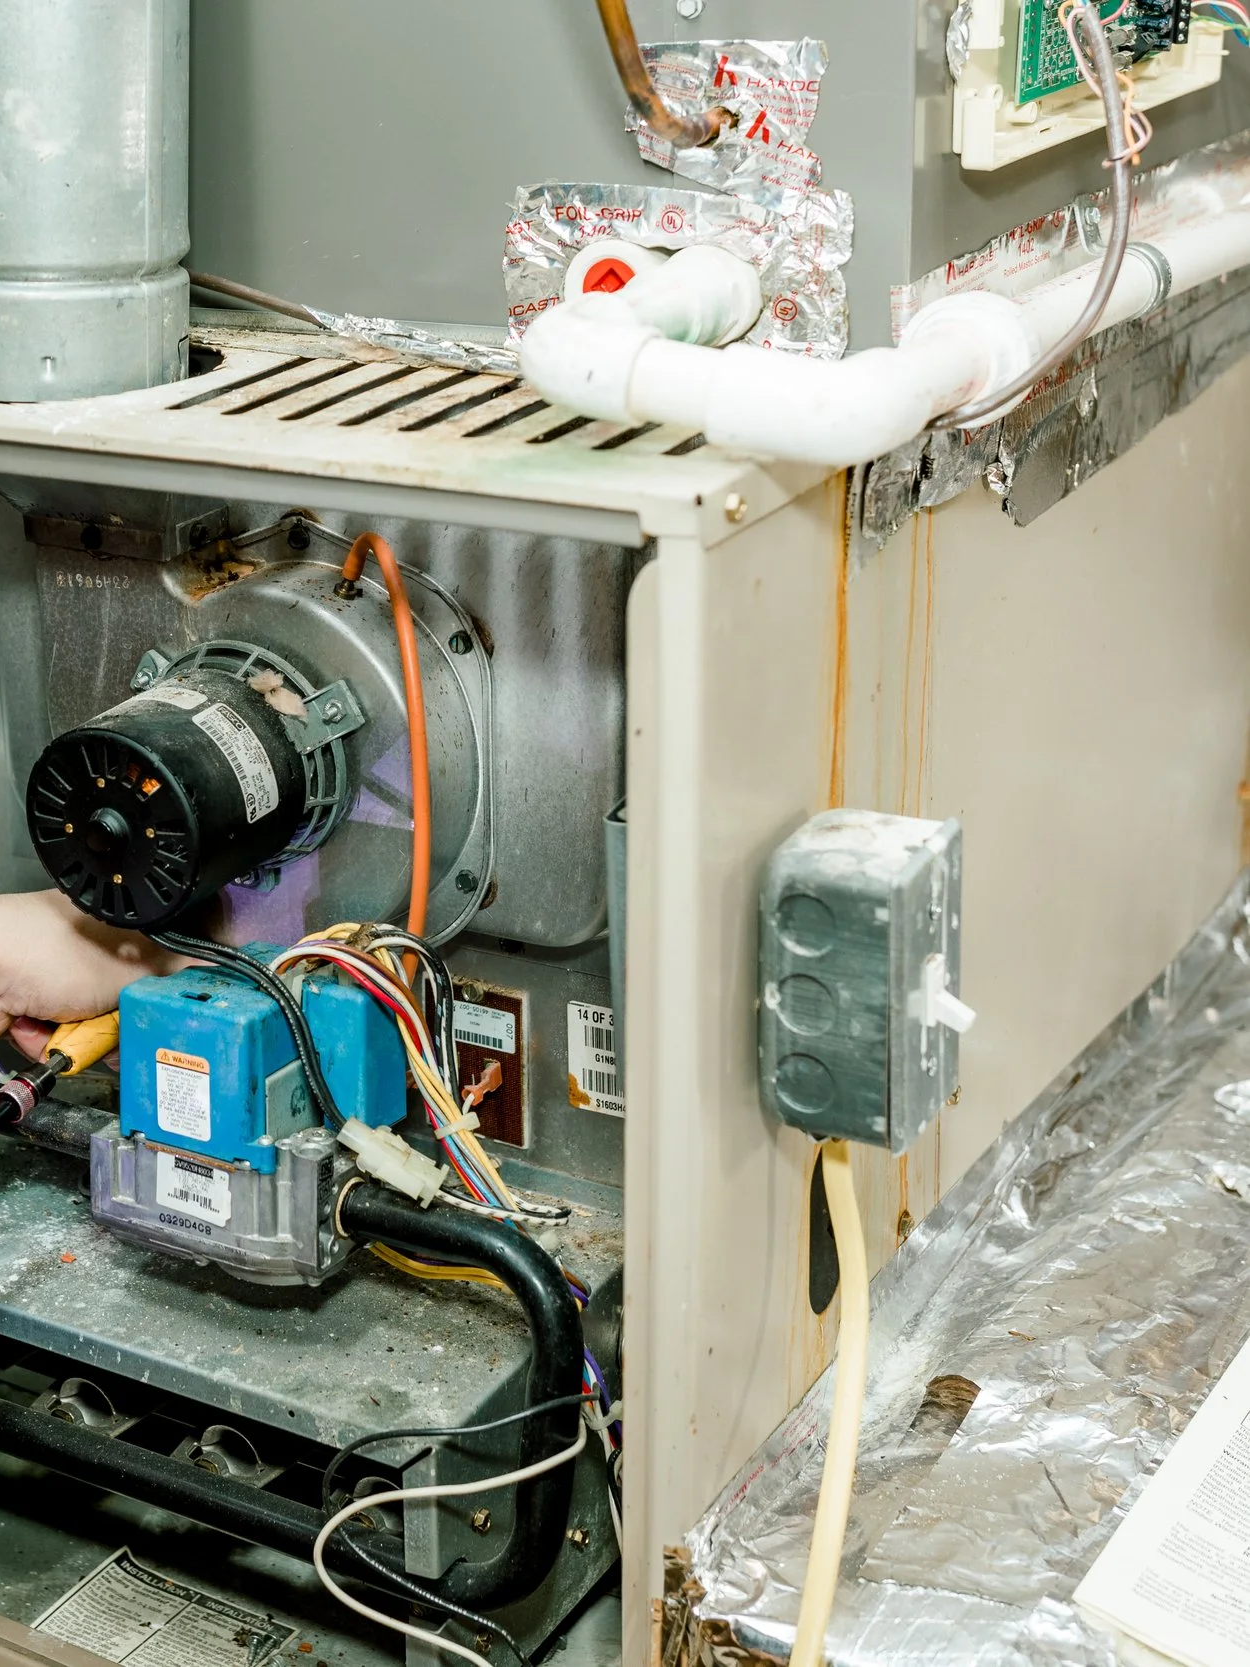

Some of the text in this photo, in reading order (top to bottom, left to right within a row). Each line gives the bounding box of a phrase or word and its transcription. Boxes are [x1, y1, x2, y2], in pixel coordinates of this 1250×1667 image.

[217, 706, 245, 731] FASCO
[577, 1008, 589, 1021] 14
[592, 1011, 605, 1024] OF
[505, 1023, 513, 1040] 007
[172, 1055, 205, 1069] WARNING
[119, 1560, 187, 1598] INSTALLATION
[206, 1601, 274, 1632] INSTALLATION
